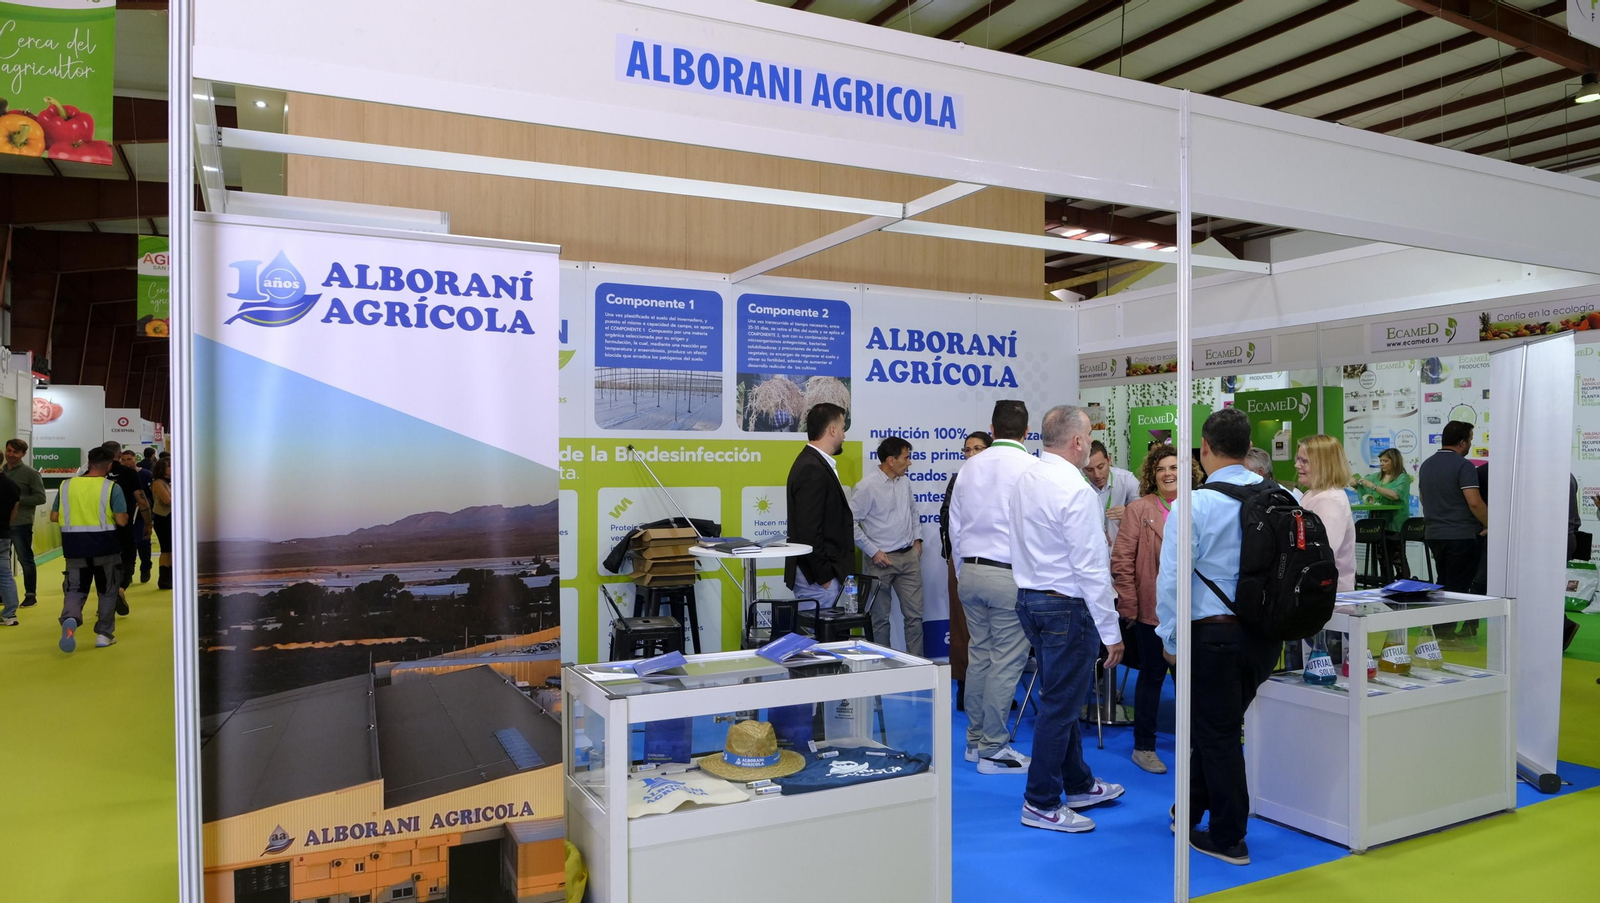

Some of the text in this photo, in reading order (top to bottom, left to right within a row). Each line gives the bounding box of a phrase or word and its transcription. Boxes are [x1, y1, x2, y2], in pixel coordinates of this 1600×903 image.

[0, 19, 97, 60] Cerca del
[1, 52, 96, 95] agricultor
[626, 40, 957, 130] ALBORANI AGRICOLA
[321, 262, 534, 302] ALBORANÍ
[262, 276, 301, 290] años
[320, 295, 536, 335] AGRÍCOLA
[606, 293, 695, 310] Componente 1
[748, 303, 829, 318] Componente 2
[1496, 303, 1595, 323] Confía en la ecología
[865, 326, 1018, 358] ALBORANÍ
[1386, 336, 1439, 348] www.ecamed.es
[865, 355, 1019, 388] AGRÍCOLA
[1205, 358, 1243, 367] www.ecamed.es
[1249, 373, 1273, 381] PRODUCTOS
[1247, 396, 1298, 413] ECAMED
[870, 426, 930, 444] nutrición
[559, 444, 762, 463] de la Biodesinfección
[754, 519, 777, 528] Hacen
[304, 816, 421, 847] ALBORANI
[429, 800, 535, 830] AGRICOLA
